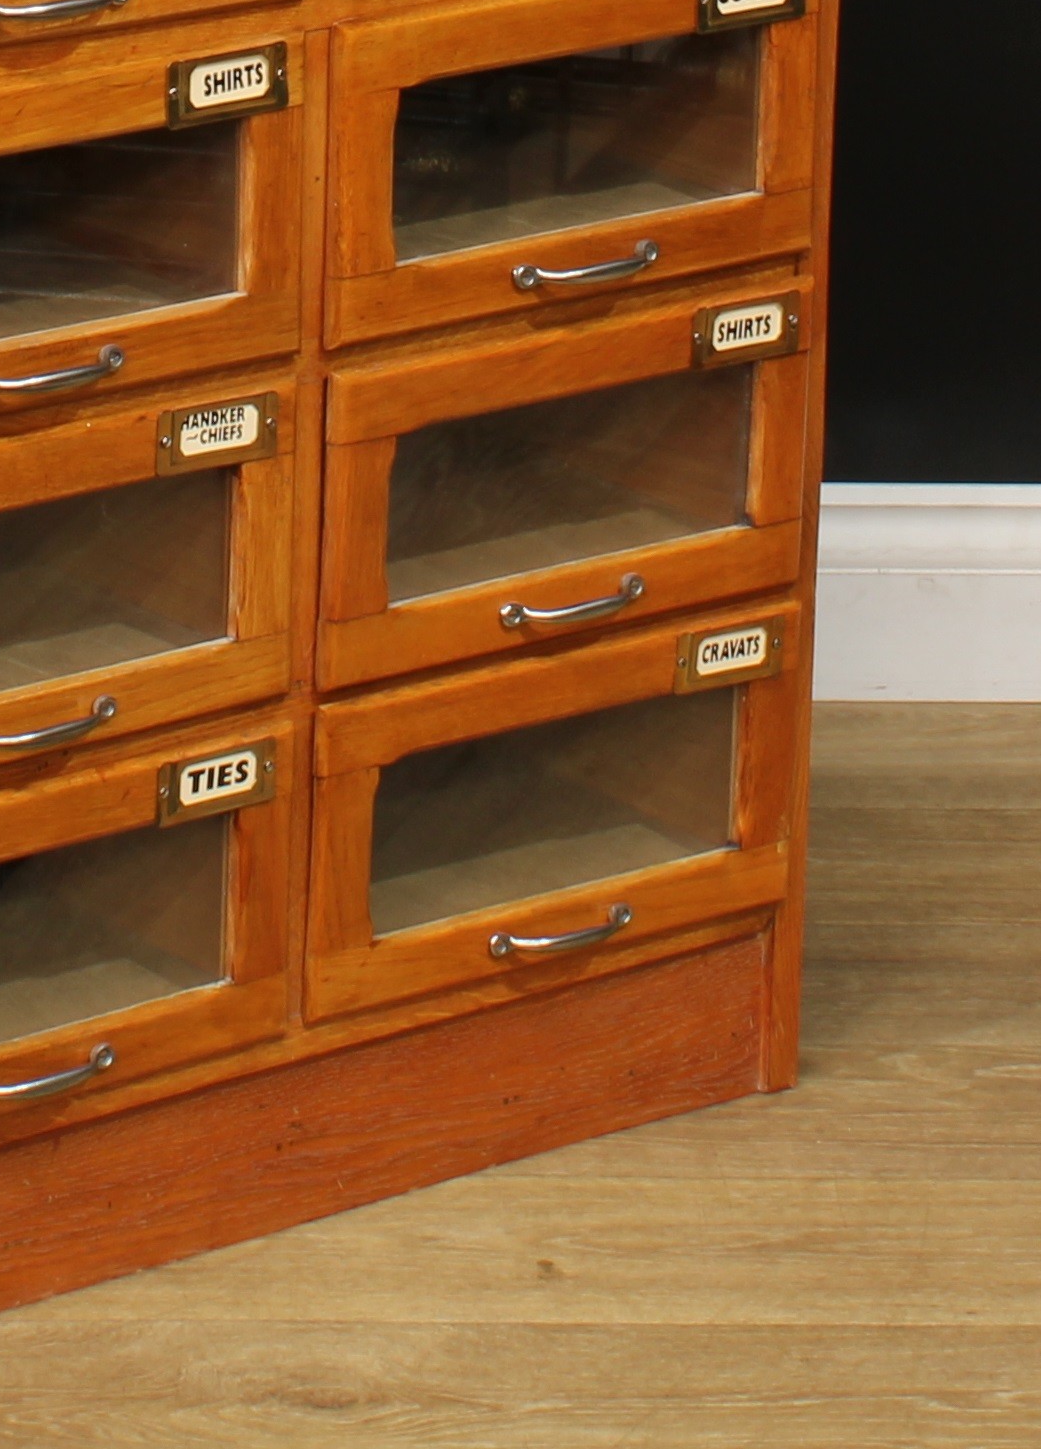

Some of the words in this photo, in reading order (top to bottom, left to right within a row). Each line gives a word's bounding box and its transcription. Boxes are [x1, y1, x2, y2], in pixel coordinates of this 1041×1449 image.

[204, 63, 262, 97] SHIRTS
[717, 314, 771, 343] SHIRTS
[702, 635, 760, 664] CRAVATS
[187, 759, 249, 794] TIES
